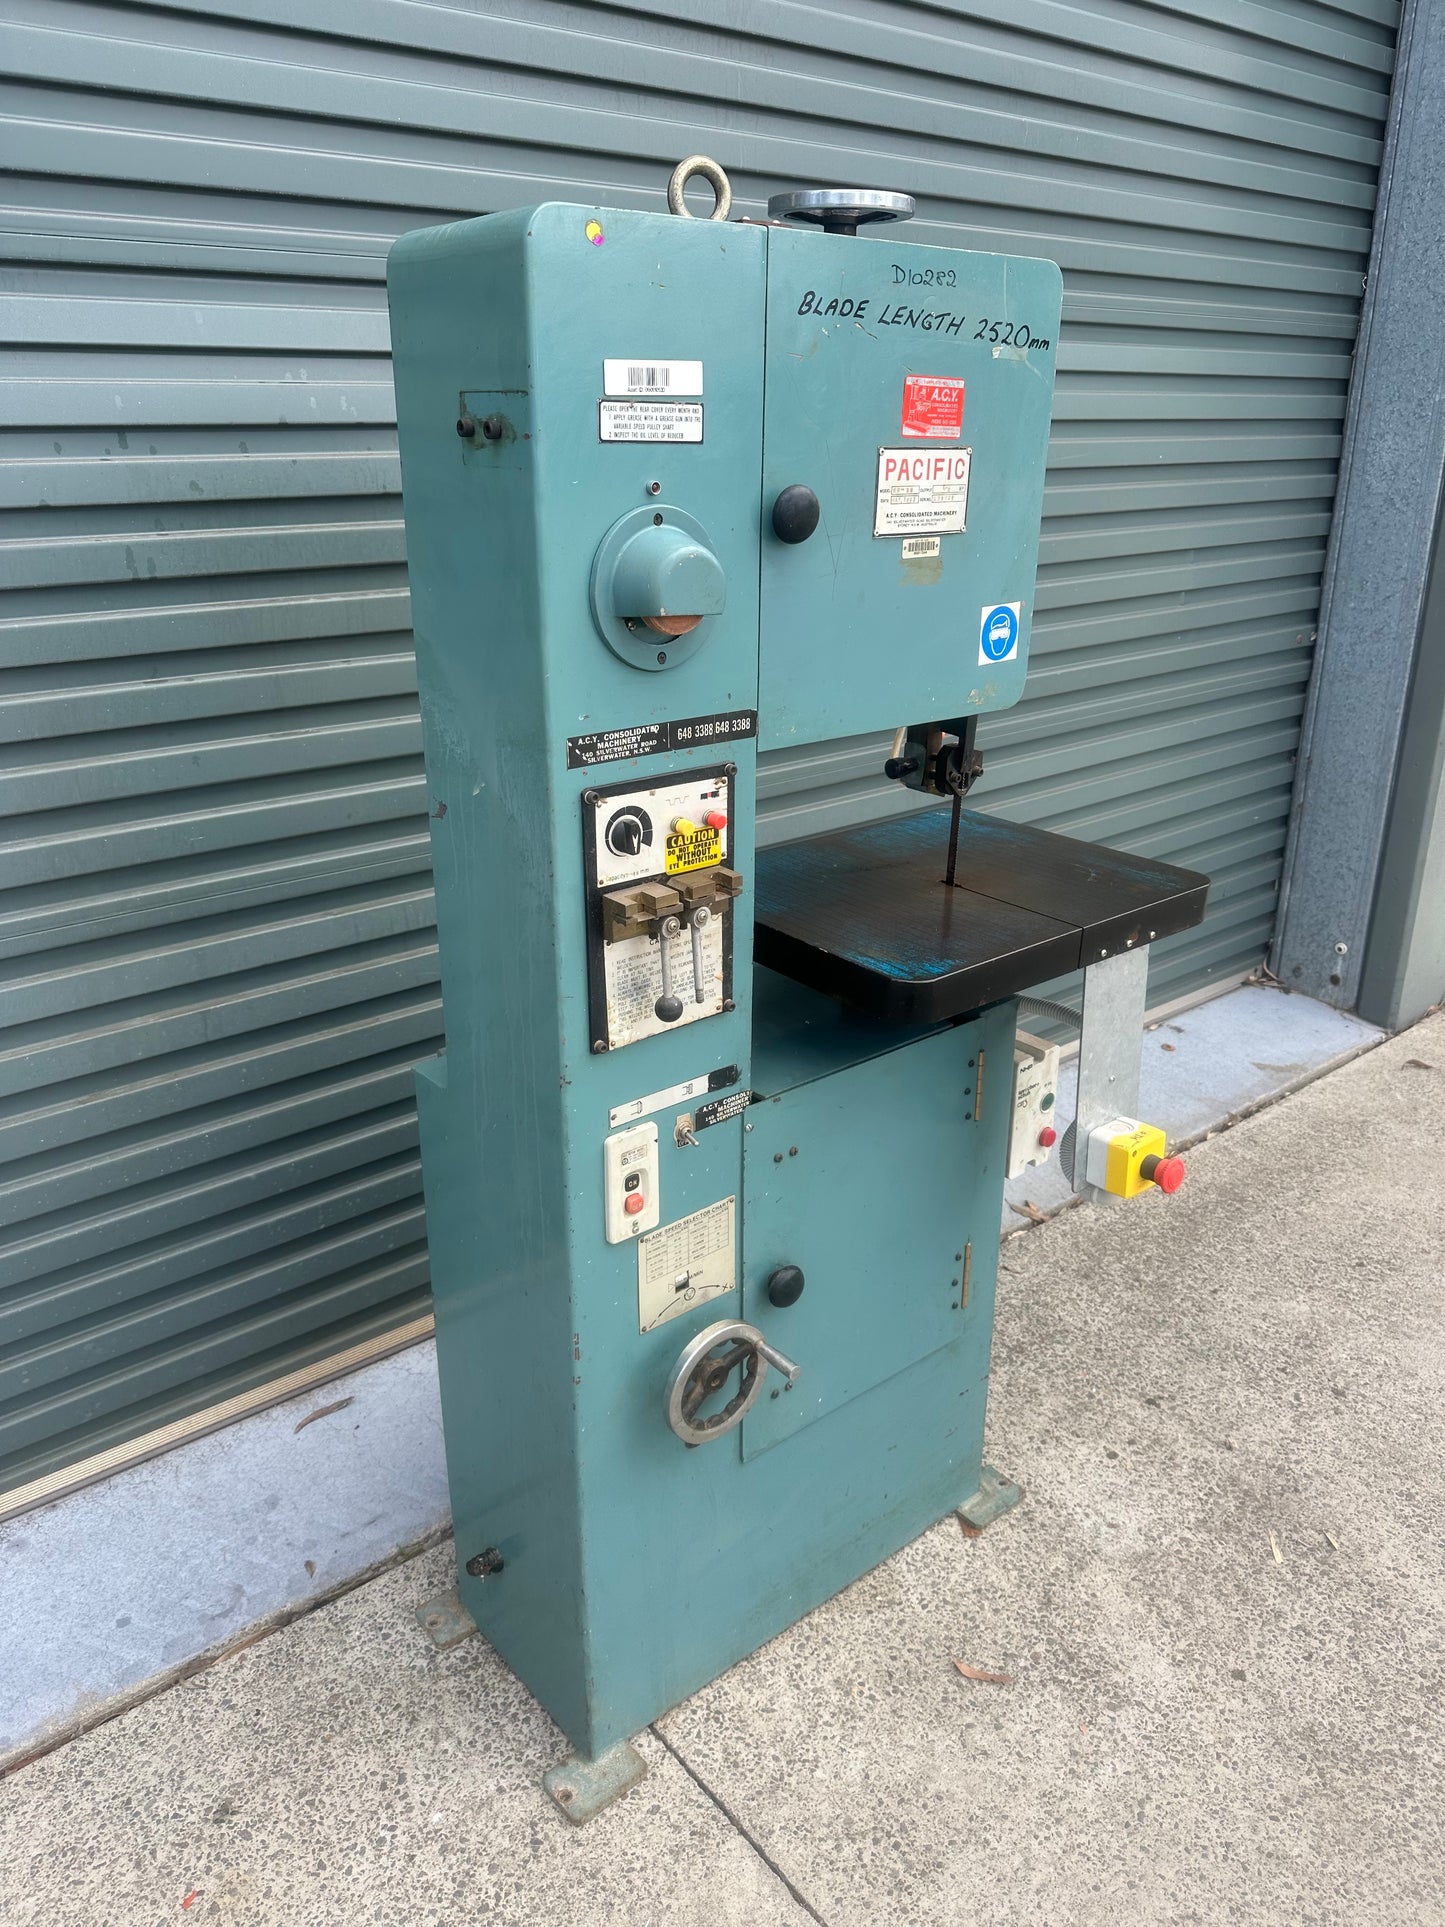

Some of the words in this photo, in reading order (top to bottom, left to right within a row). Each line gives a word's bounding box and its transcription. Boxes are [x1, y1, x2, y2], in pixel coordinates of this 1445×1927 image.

[797, 290, 870, 319] BLADE
[878, 304, 966, 337] LENGTH
[931, 388, 958, 402] A.C.Y.
[885, 458, 965, 481] PACIFIC
[578, 736, 600, 745] A.C.Y.
[604, 725, 659, 740] CONSOLIDATED
[677, 727, 692, 740] 648
[694, 723, 714, 738] 3388
[715, 721, 730, 734] 648
[732, 718, 751, 732] 3388
[597, 735, 642, 749] MACHINERY
[596, 744, 638, 756] SILVERWATER
[671, 829, 714, 847] CAUTION
[694, 840, 718, 850] OPERATE
[676, 847, 711, 862] WITHOUT
[684, 854, 718, 866] PROTECTION
[703, 1102, 720, 1112] A.C.Y.
[717, 1101, 750, 1117] SILVERWATER
[644, 1232, 662, 1243] BLADE
[665, 1223, 682, 1233] SPEED
[683, 1210, 710, 1225] SELECTOR
[712, 1201, 729, 1212] CHART
